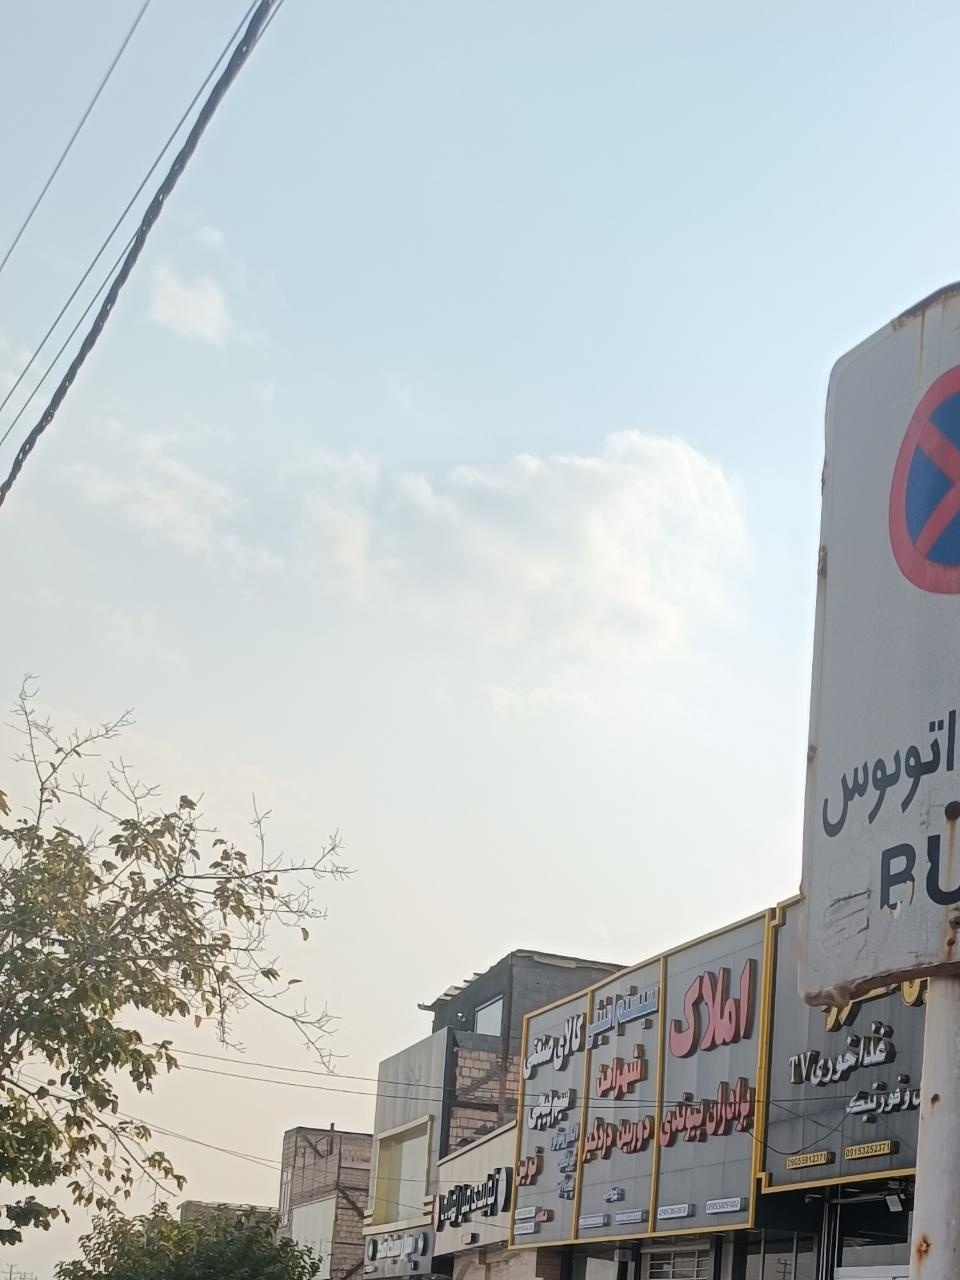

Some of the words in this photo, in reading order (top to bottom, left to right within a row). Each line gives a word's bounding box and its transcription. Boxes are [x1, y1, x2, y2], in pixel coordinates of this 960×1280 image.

[822, 709, 957, 838] اتوبوس
[668, 958, 755, 1058] املاک
[616, 1116, 653, 1155] دوربین
